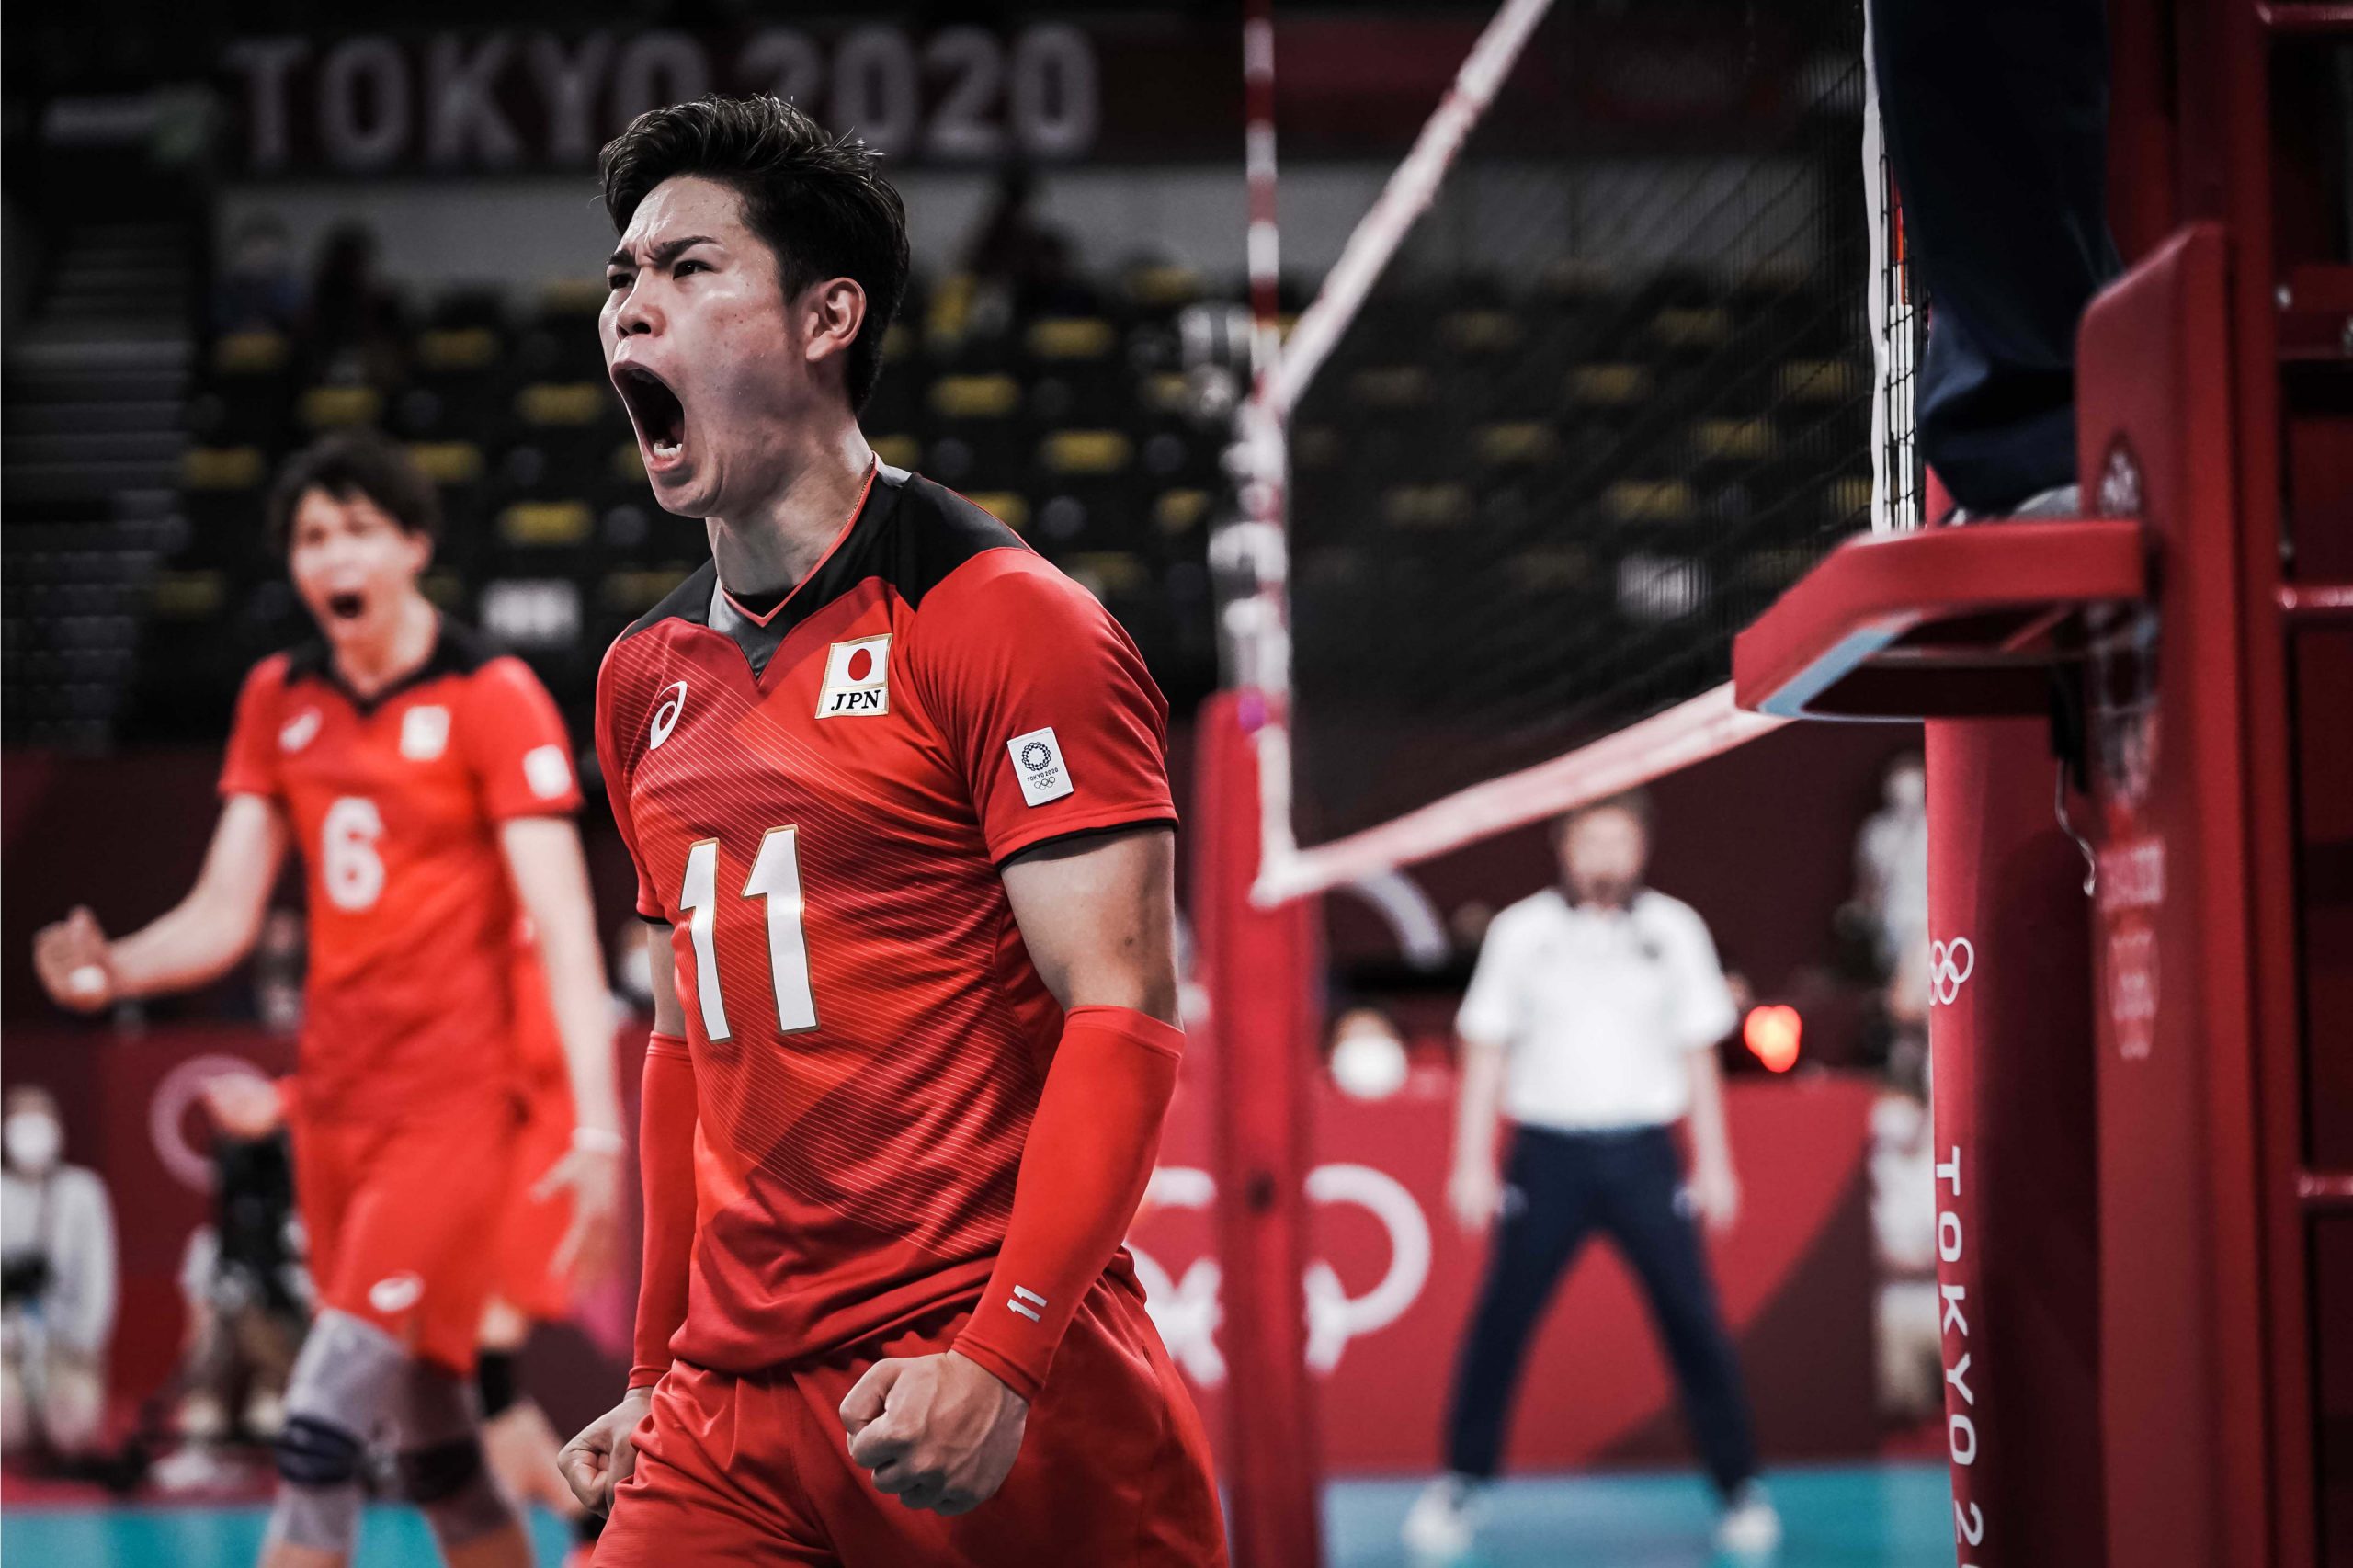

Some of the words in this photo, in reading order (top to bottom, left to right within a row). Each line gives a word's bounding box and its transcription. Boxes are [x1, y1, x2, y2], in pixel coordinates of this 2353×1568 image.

[222, 33, 711, 171] TOKYO
[734, 24, 1102, 160] 2020
[831, 689, 881, 711] JPN
[1027, 772, 1045, 782] TOKYO
[1044, 767, 1059, 778] 2020
[323, 796, 386, 912] 6
[678, 824, 821, 1045] 11
[1007, 1284, 1048, 1323] 11
[1936, 1145, 1977, 1466] TOKYO
[1954, 1500, 1984, 1568] 2
